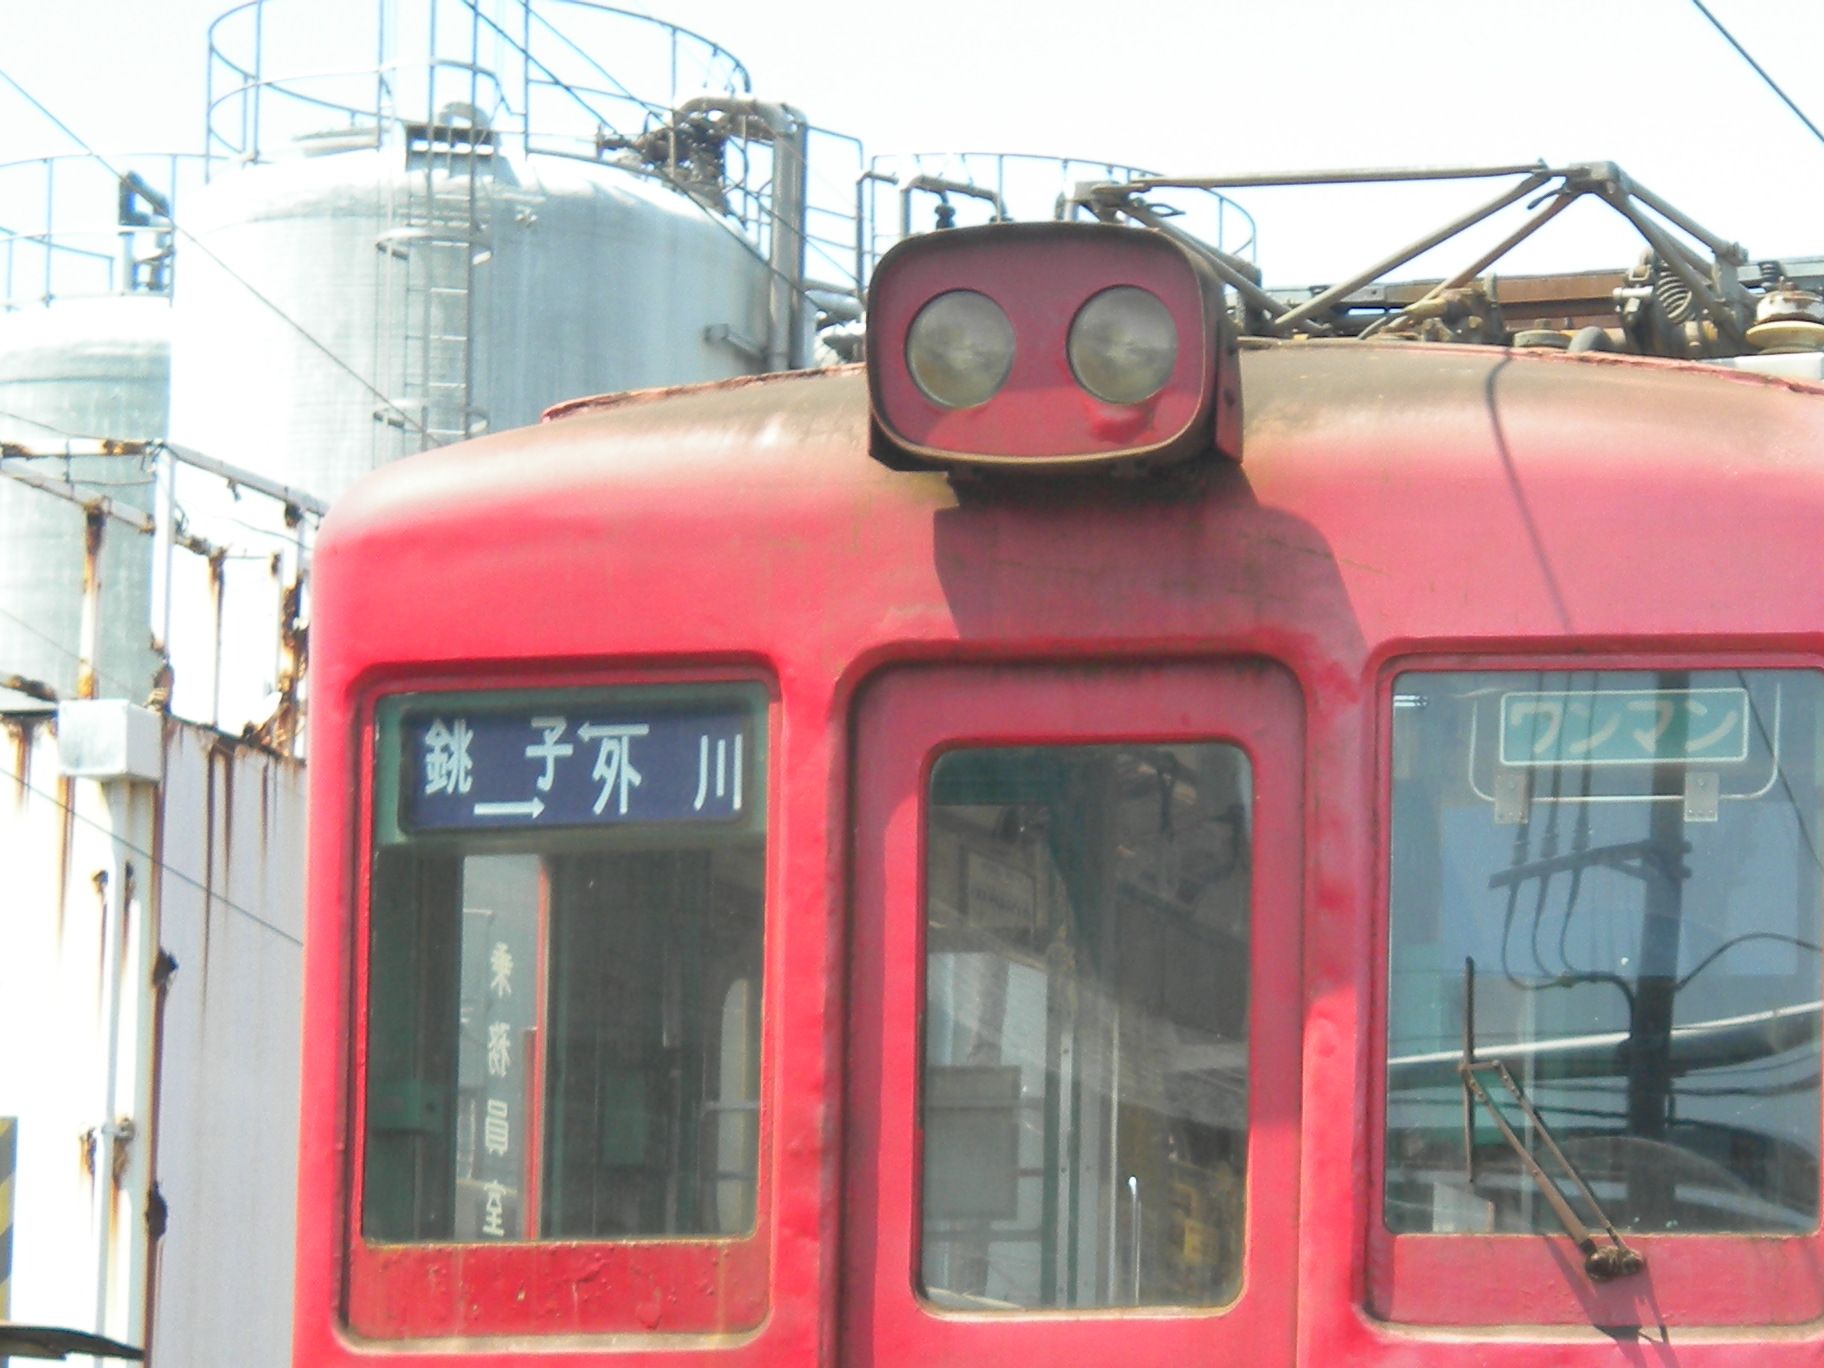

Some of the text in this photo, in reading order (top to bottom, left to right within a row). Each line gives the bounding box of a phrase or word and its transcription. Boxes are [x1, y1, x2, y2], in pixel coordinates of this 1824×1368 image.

[1510, 700, 1738, 754] ワンマン
[424, 716, 743, 815] 銚子 外川
